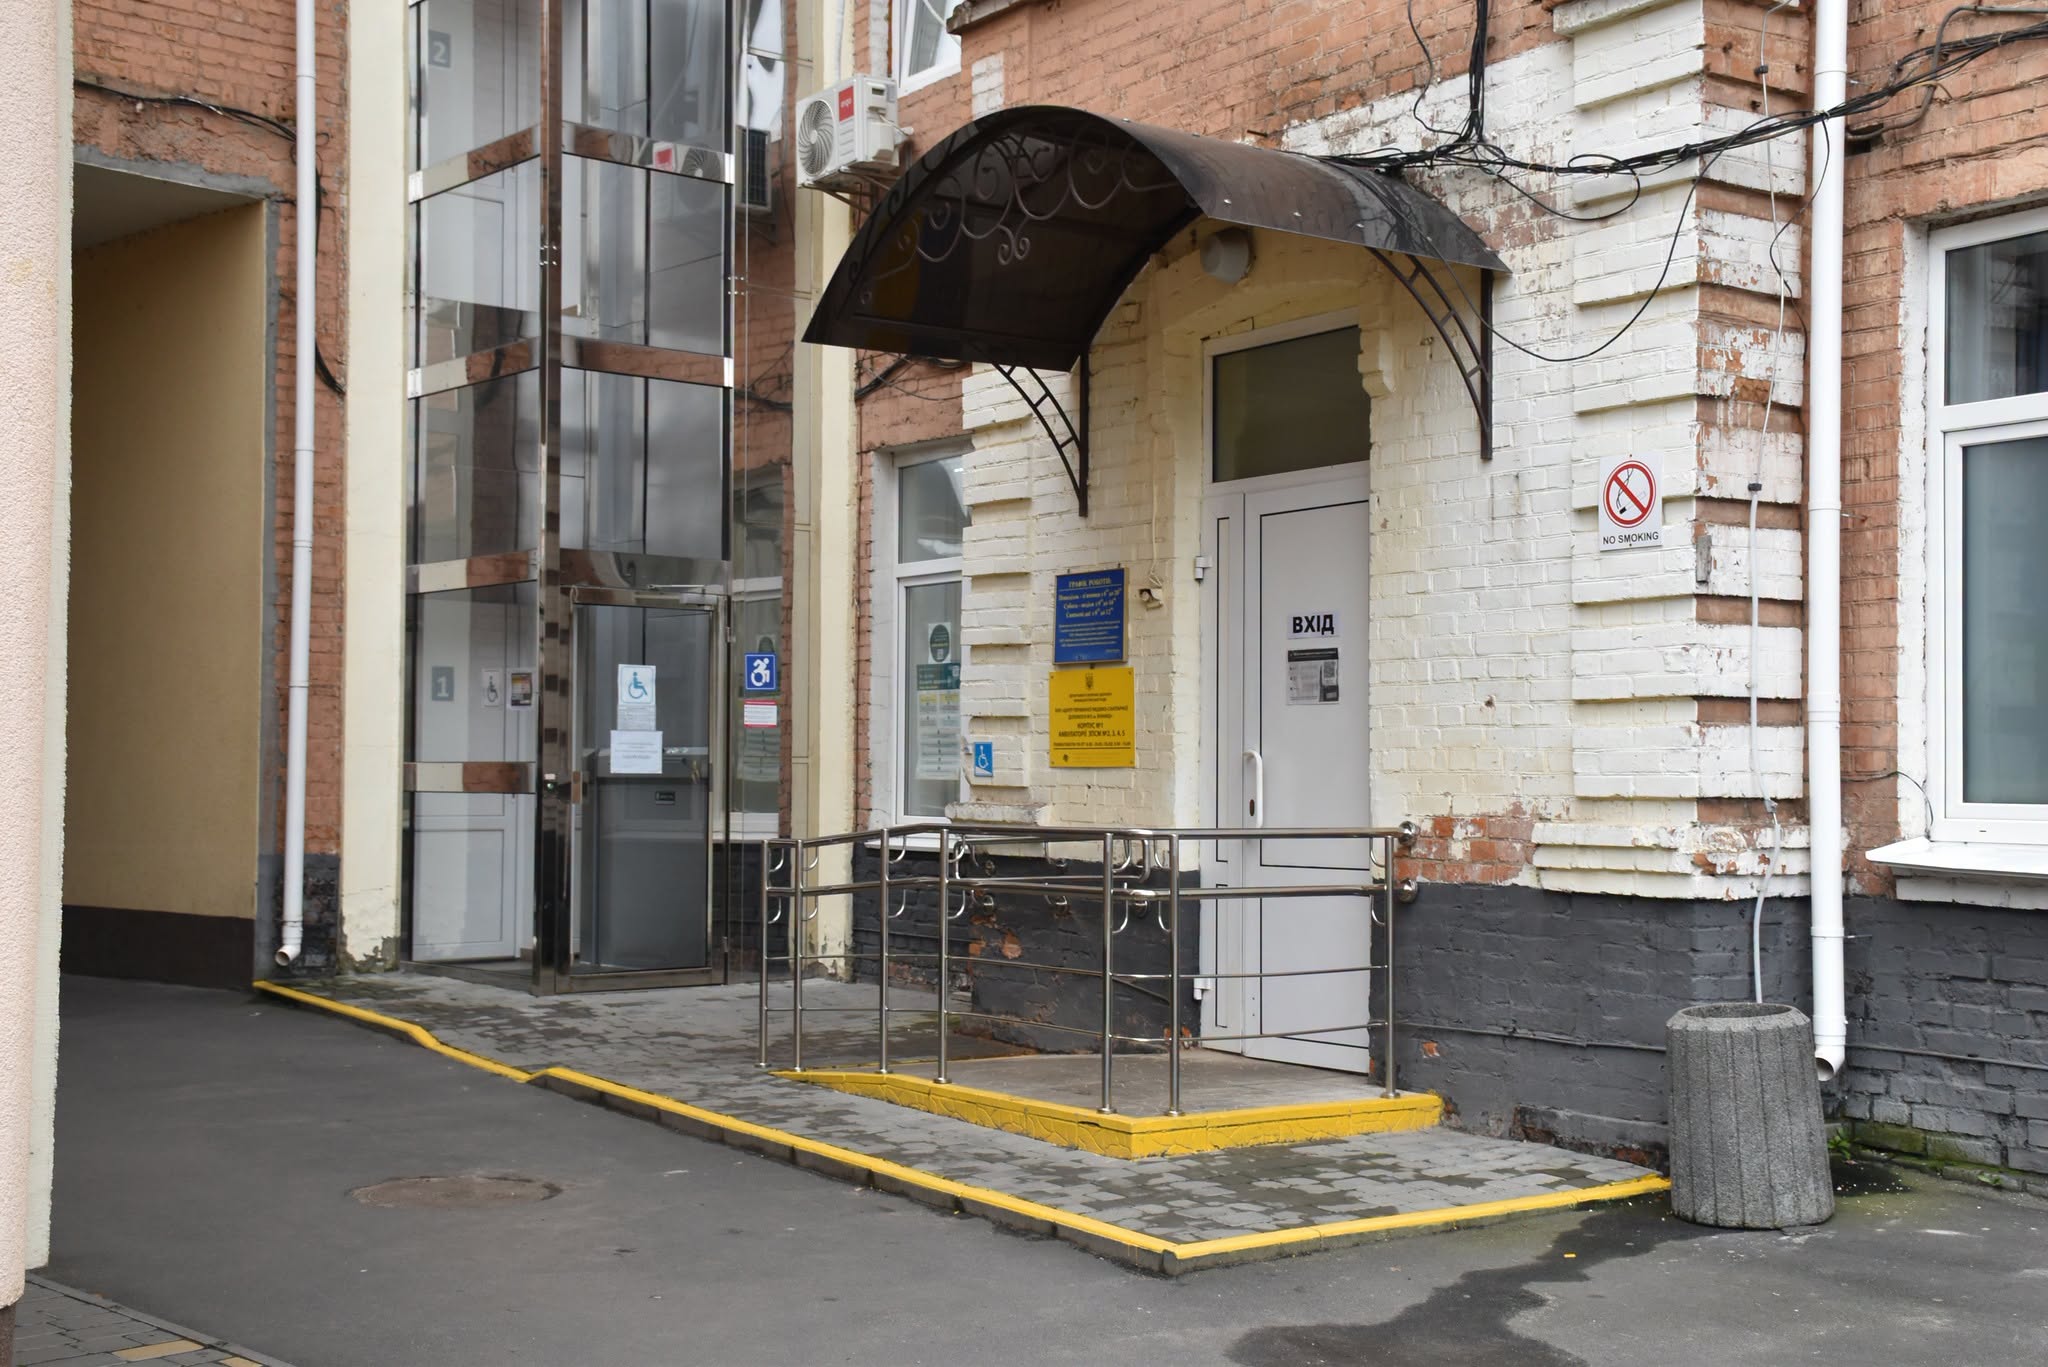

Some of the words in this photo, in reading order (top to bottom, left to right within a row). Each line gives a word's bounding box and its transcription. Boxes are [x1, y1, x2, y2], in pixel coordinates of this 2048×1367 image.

[433, 42, 447, 63] 2
[1603, 535, 1616, 545] NO
[1618, 531, 1659, 544] SMOKING
[1293, 614, 1334, 635] ВХІД
[437, 676, 449, 697] 1
